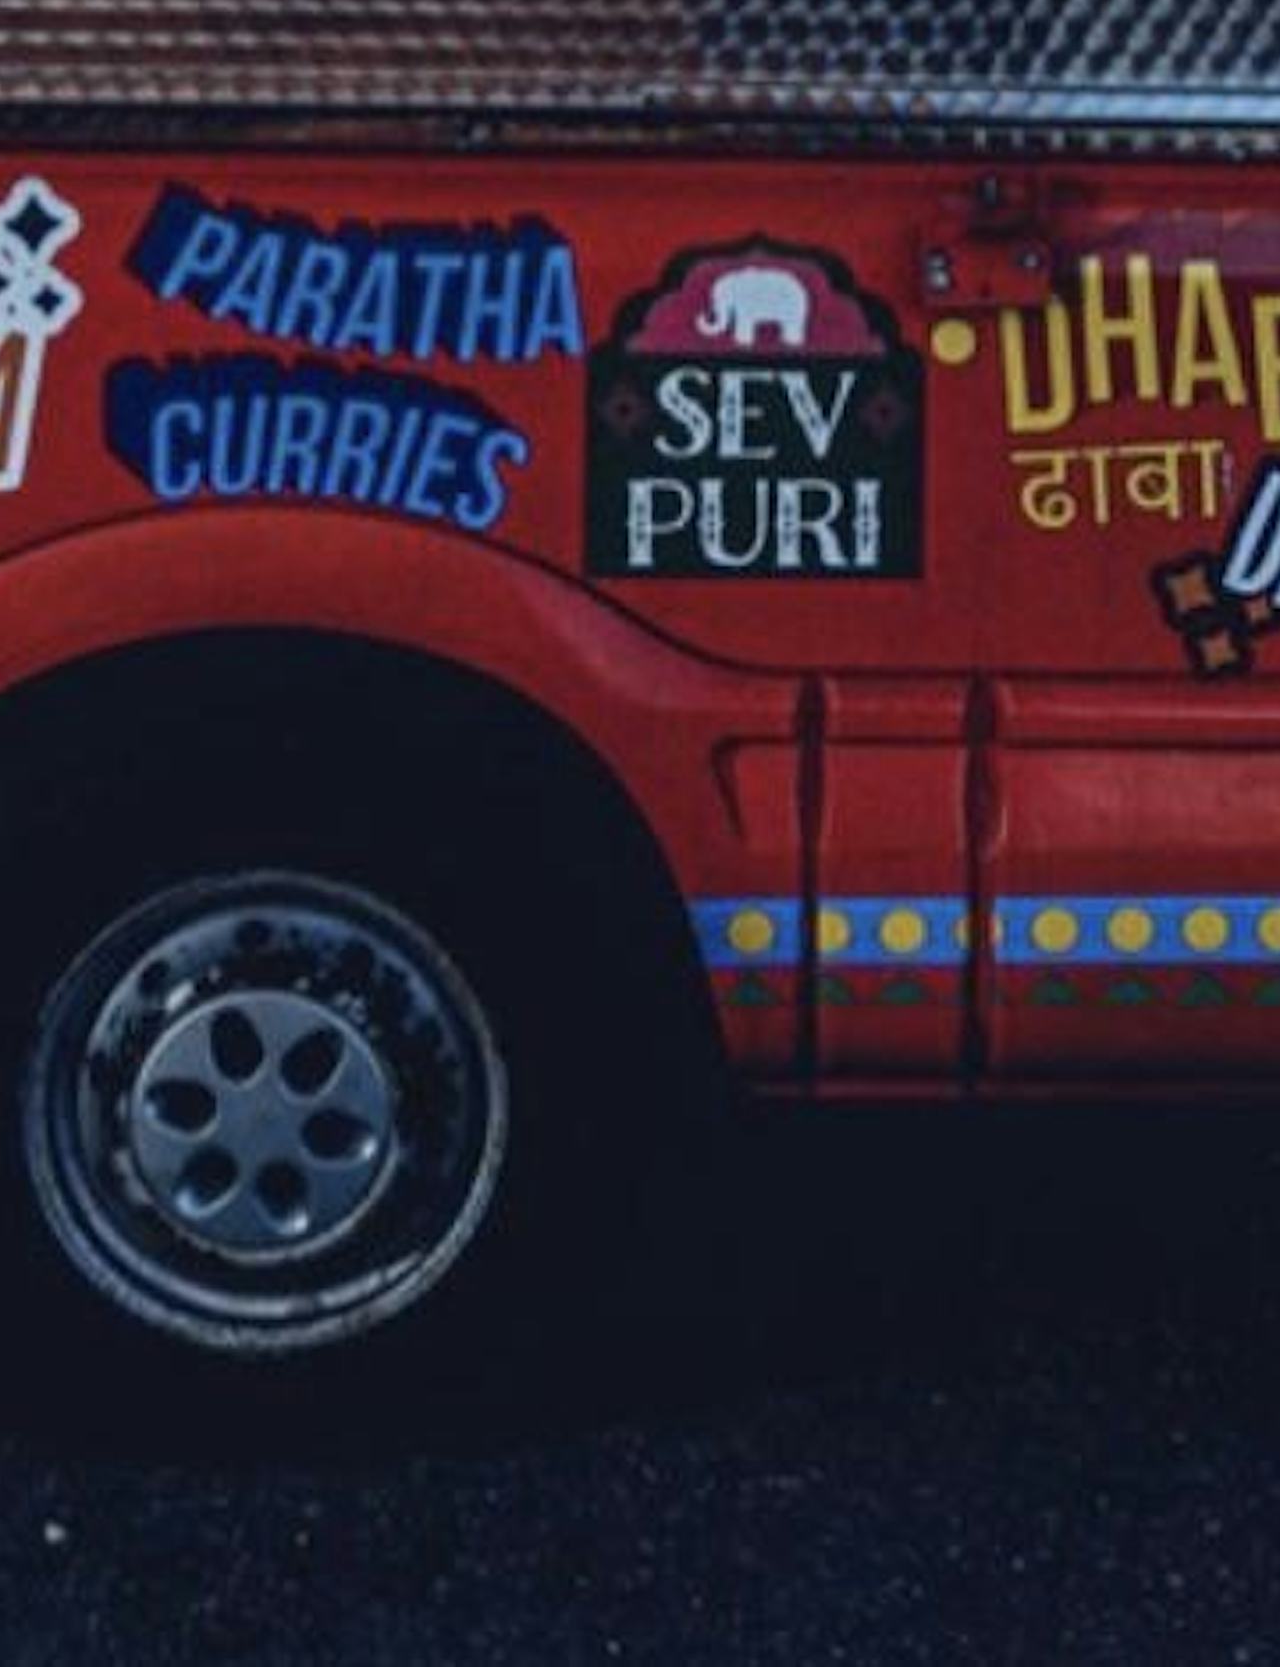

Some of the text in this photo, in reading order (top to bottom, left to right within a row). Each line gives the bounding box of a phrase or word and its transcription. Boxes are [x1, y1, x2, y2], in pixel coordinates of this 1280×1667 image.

[156, 212, 586, 362] PARATHA
[653, 365, 856, 460] SEV
[149, 393, 530, 531] CURRIES
[1010, 439, 1226, 530] ढाबा
[626, 477, 882, 568] PURI
